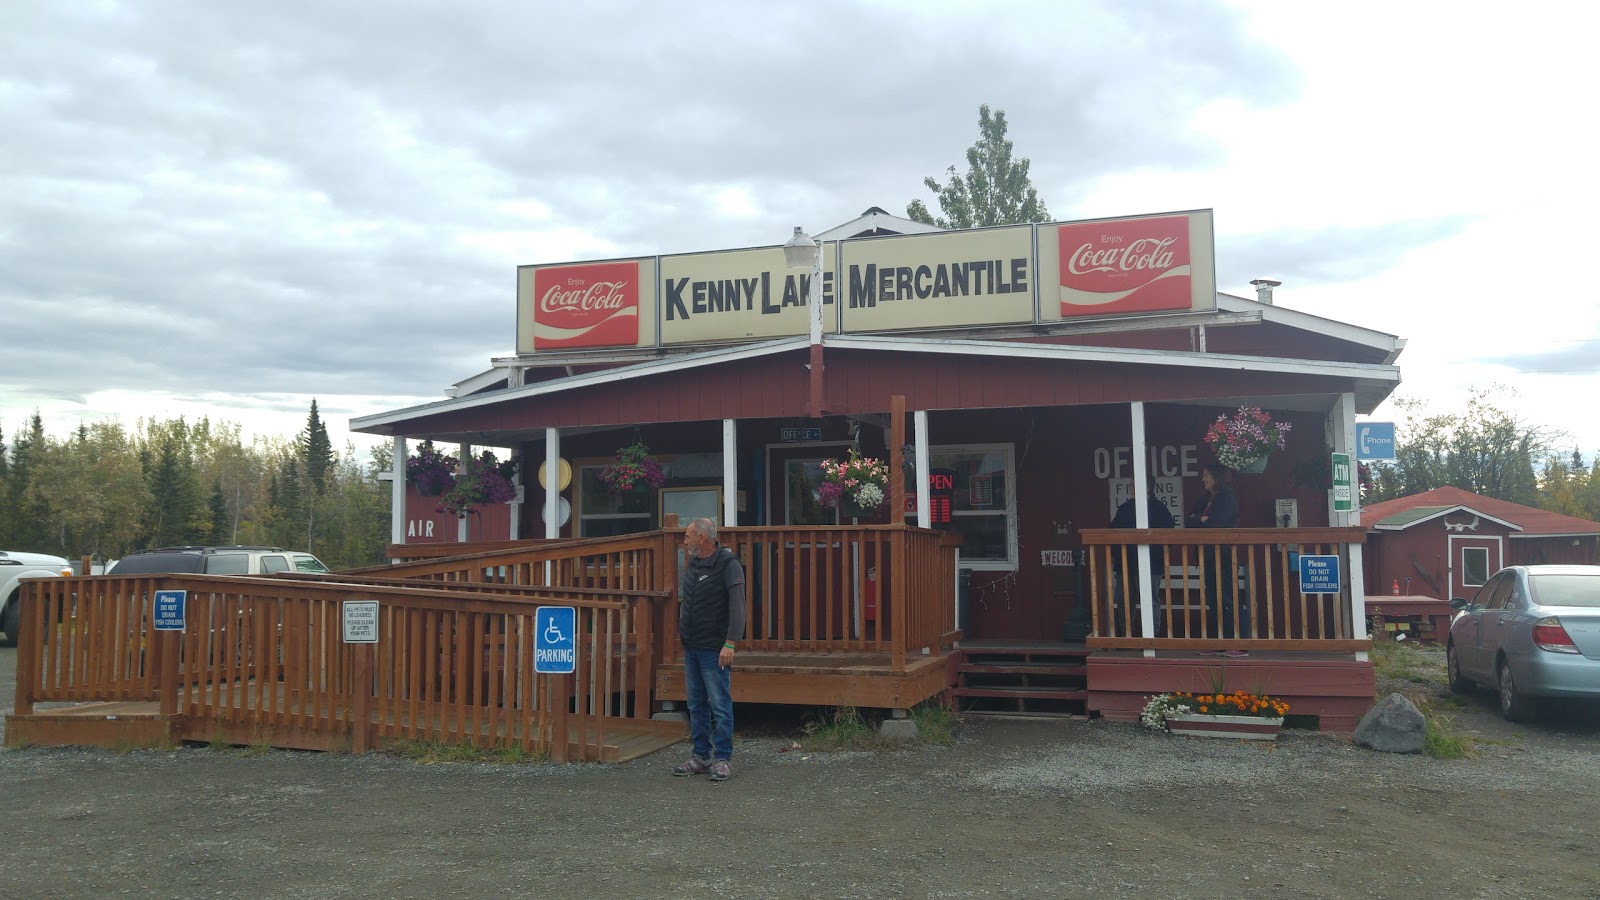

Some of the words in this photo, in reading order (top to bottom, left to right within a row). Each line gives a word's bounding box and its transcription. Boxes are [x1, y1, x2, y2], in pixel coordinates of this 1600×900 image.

[1101, 235, 1123, 243] Enjoy
[1068, 236, 1178, 275] Coca-Cola
[567, 278, 585, 286] Enjoy
[849, 257, 1028, 309] MERCANTILE
[541, 281, 628, 313] Coca-Cola
[1094, 445, 1199, 479] OFICE
[1334, 464, 1349, 481] ATM
[928, 474, 953, 490] PEN
[1116, 482, 1174, 495] FING
[1335, 488, 1349, 498] INSIDE
[408, 519, 434, 538] AIR
[1044, 551, 1073, 565] WELCO
[1307, 559, 1327, 567] Please
[160, 595, 176, 603] Please
[536, 649, 573, 663] PARKING
